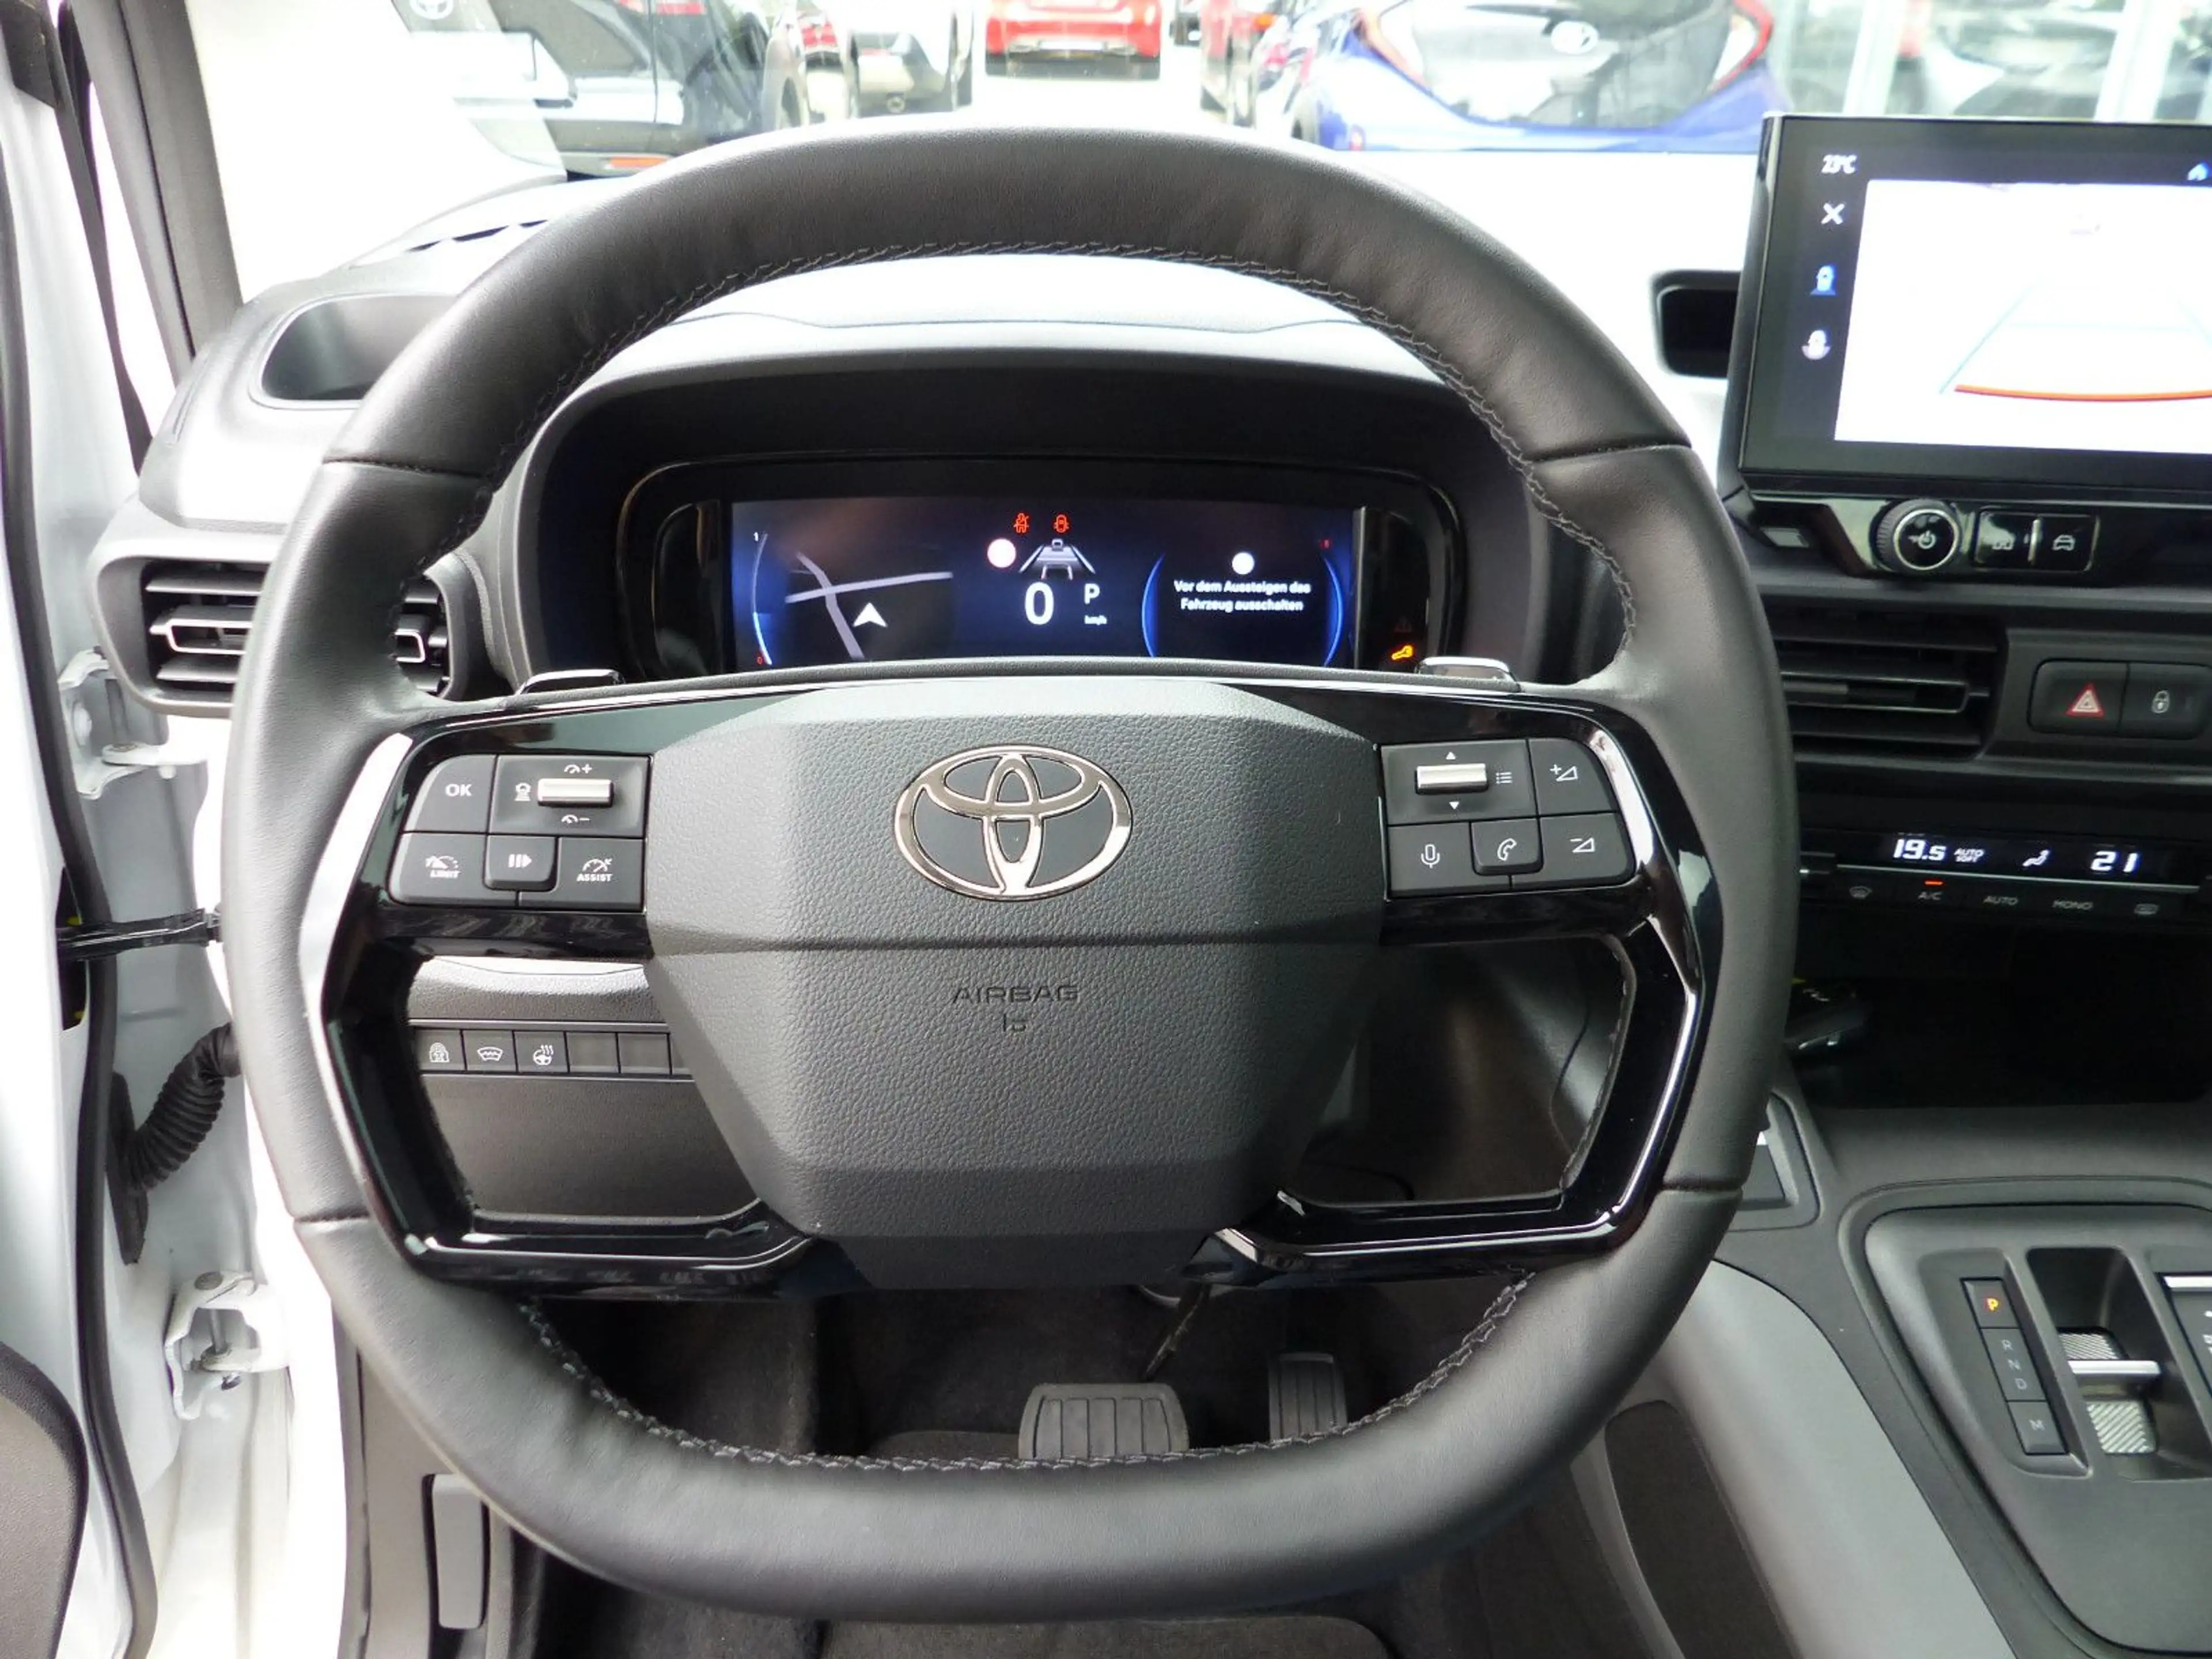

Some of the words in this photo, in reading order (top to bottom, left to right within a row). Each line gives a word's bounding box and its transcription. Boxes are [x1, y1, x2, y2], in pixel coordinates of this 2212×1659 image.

[1084, 583, 1100, 604] P
[1173, 580, 1194, 592] Vor
[1195, 580, 1222, 593] dem
[1224, 581, 1287, 596] Aussteigen
[1024, 581, 1054, 626] 0
[1180, 597, 1233, 613] Fahrzeug
[1234, 599, 1304, 611] ausschalten
[445, 783, 472, 797] OK
[1893, 839, 1947, 861] 19.5
[1953, 848, 1986, 858] AUTO
[2090, 851, 2138, 873] 21
[576, 873, 613, 882] ASSIST
[1918, 892, 1942, 900] A/C
[1983, 895, 2018, 906] AUTO
[2052, 900, 2093, 911] MONO
[953, 985, 1078, 1003] AIRBAG
[1986, 1297, 2000, 1312] P
[2001, 1339, 2013, 1351] R
[2007, 1359, 2021, 1371] N
[2014, 1378, 2028, 1390] D
[2029, 1419, 2045, 1431] M
